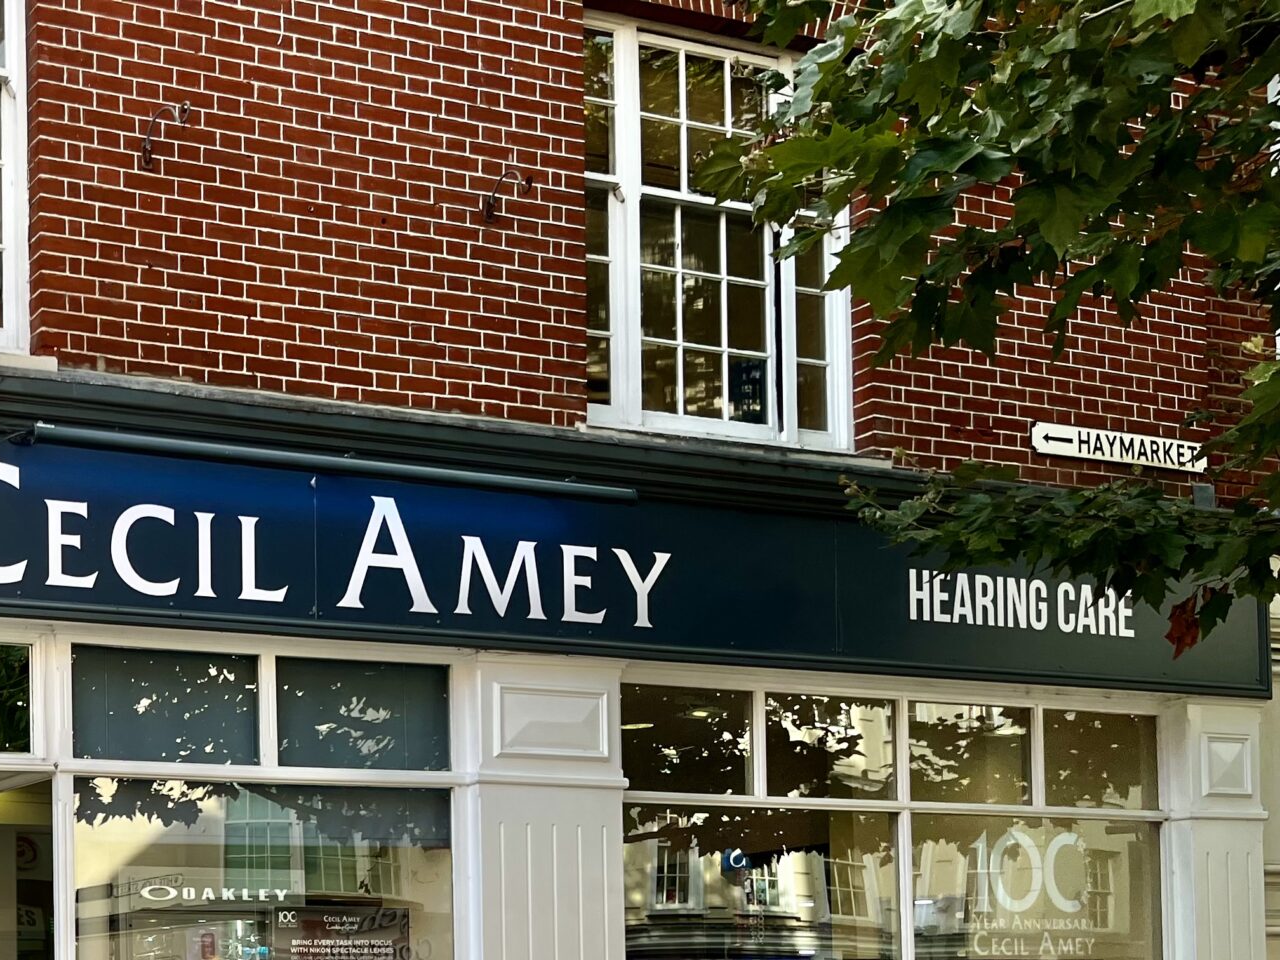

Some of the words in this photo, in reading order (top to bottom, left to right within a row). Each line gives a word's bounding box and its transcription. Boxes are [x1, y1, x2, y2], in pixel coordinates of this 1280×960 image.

[1078, 430, 1201, 469] HAYMARKET
[336, 495, 672, 629] AMEY
[908, 568, 1048, 632] HEARING
[1057, 581, 1136, 638] CARE
[181, 886, 288, 902] OAKLEY
[973, 930, 1030, 956] CECIL
[1038, 931, 1095, 955] AMEY
